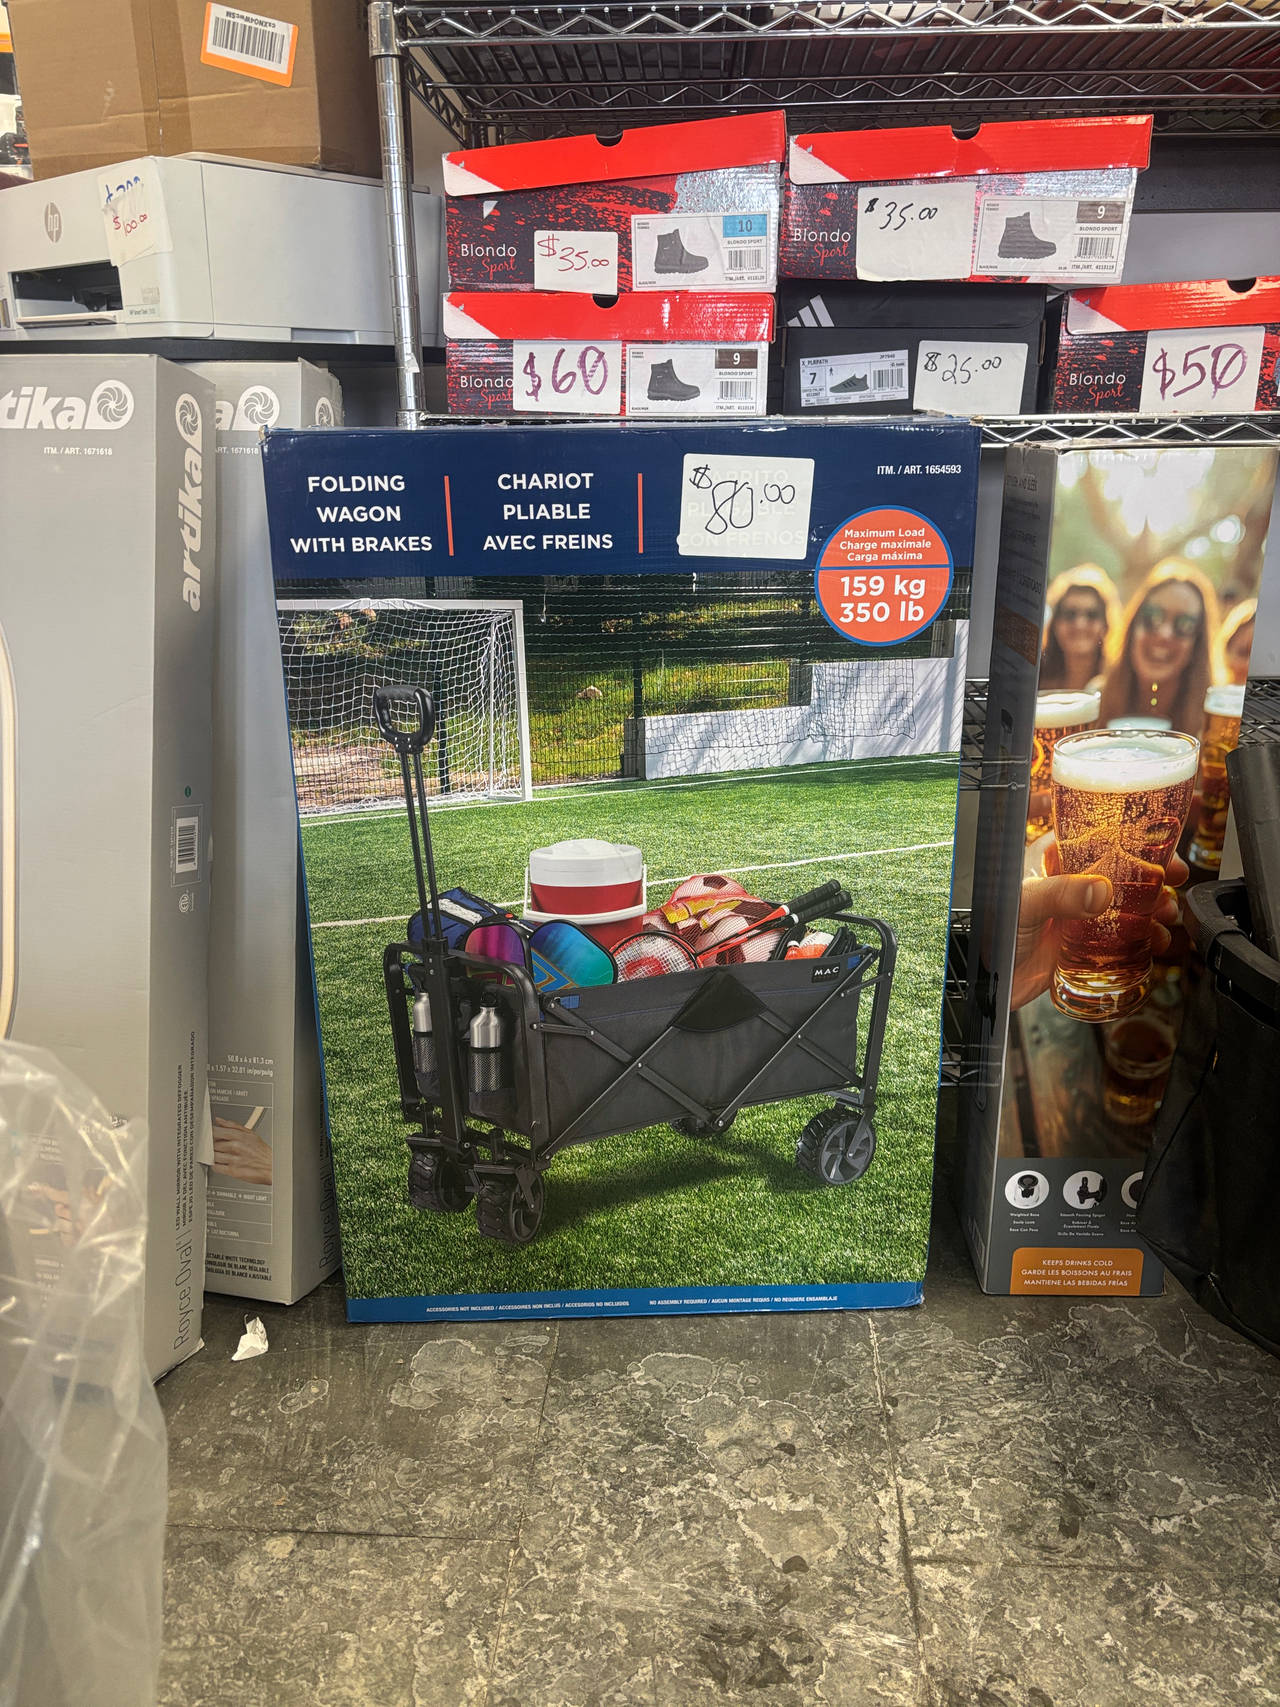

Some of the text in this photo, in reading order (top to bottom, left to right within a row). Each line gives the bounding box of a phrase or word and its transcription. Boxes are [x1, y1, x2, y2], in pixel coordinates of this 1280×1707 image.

[1097, 206, 1105, 219] 9
[738, 220, 752, 233] 10
[794, 228, 851, 243] Blondo
[461, 244, 517, 258] Blondo
[813, 242, 850, 264] Sport
[481, 257, 517, 281] Sport
[733, 353, 740, 365] 9
[523, 345, 608, 402] $60
[810, 372, 817, 384] 7
[1069, 371, 1126, 385] Blondo
[1153, 344, 1247, 400] $50
[1087, 384, 1125, 402] Sport
[44, 446, 59, 455] ITM.
[65, 447, 82, 456] ART.
[83, 447, 112, 456] 1671618
[877, 465, 895, 474] ITM.
[903, 465, 922, 474] ART.
[924, 465, 961, 474] 1654593
[307, 475, 405, 492] FOLDING
[498, 472, 593, 490] CHARIOT
[689, 464, 796, 535] $80.00
[316, 506, 401, 523] WAGON
[503, 504, 590, 520] PLIABLE
[178, 447, 202, 612] artika
[845, 528, 925, 538] Maximum Load
[290, 536, 432, 553] WITH BRAKES
[483, 534, 613, 550] AVEC FREINS
[840, 540, 931, 551] Charge maximale
[848, 552, 922, 562] Carga máxima
[841, 575, 925, 600] 159 kg
[839, 602, 924, 623] 350 lb
[814, 967, 839, 976] MAC
[319, 1214, 336, 1268] Royce
[173, 1242, 194, 1350] Royce Oval
